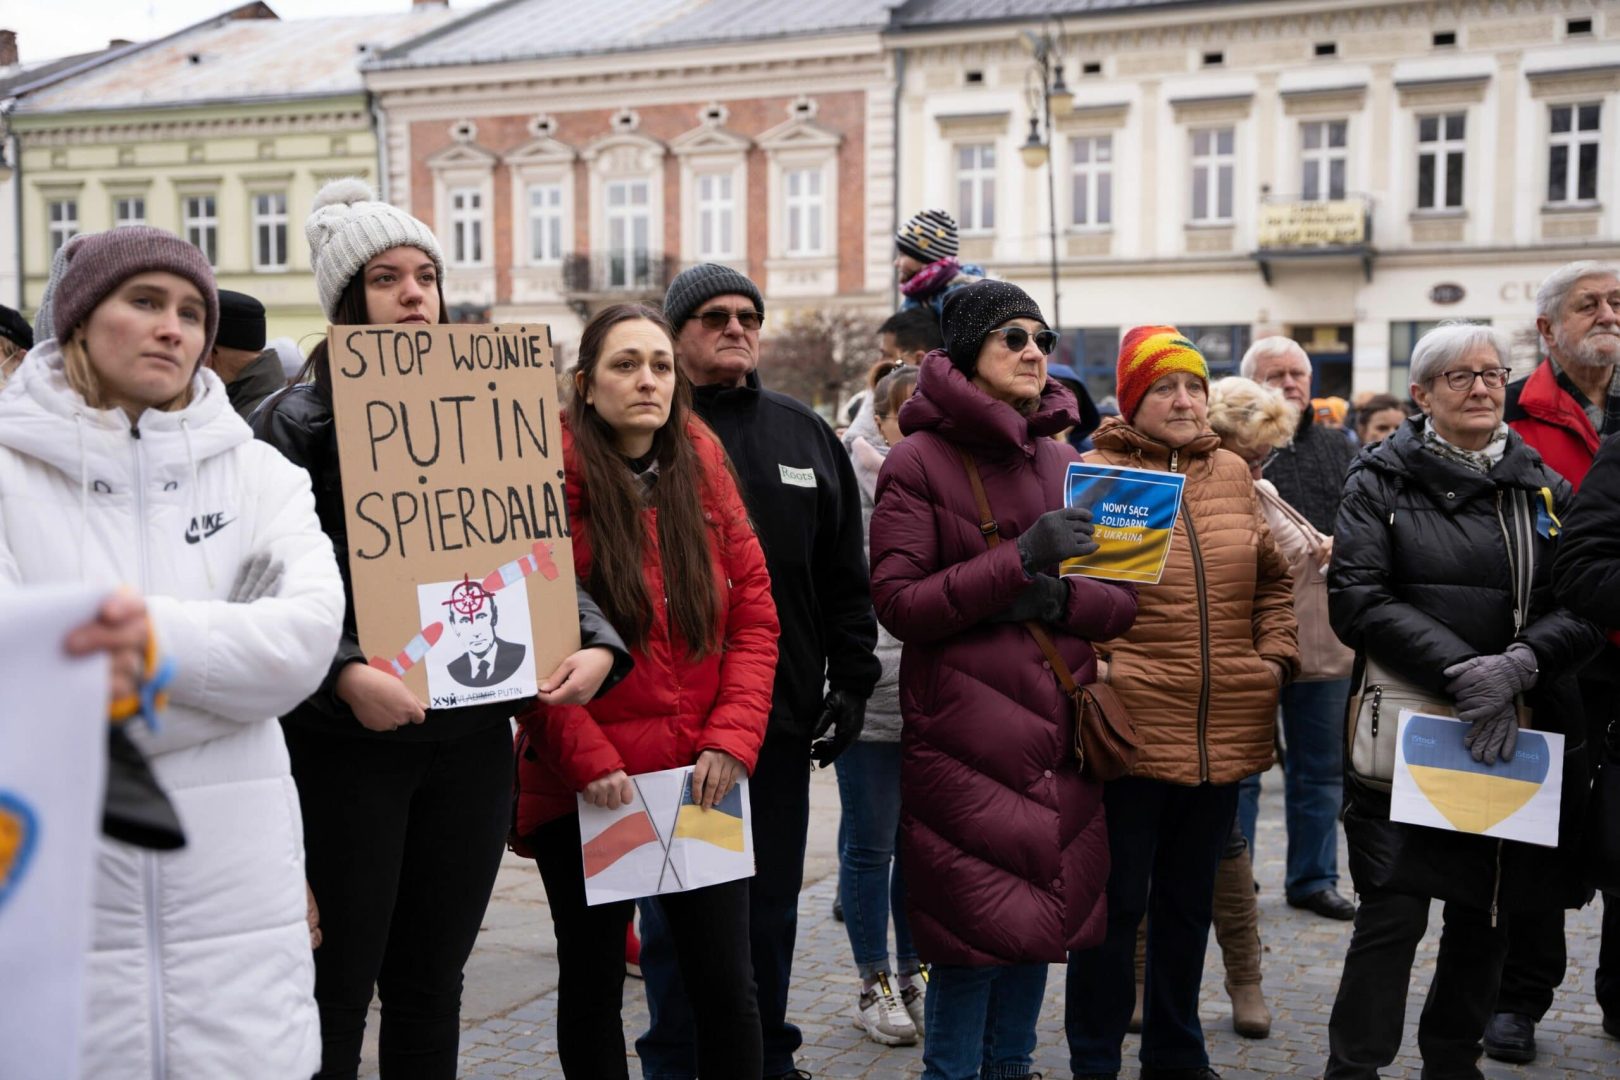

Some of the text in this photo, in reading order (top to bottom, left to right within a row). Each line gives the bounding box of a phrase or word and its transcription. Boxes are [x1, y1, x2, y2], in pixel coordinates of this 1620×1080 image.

[341, 330, 432, 378] STOP
[366, 382, 548, 471] PUTIN
[782, 467, 813, 481] Roots
[1102, 503, 1149, 517] NOWY SĄCZ
[190, 511, 224, 532] NIKE
[1100, 515, 1148, 528] SOLIDARNY
[1095, 528, 1143, 544] Z UKRAINĄ
[497, 687, 523, 698] PUTIN
